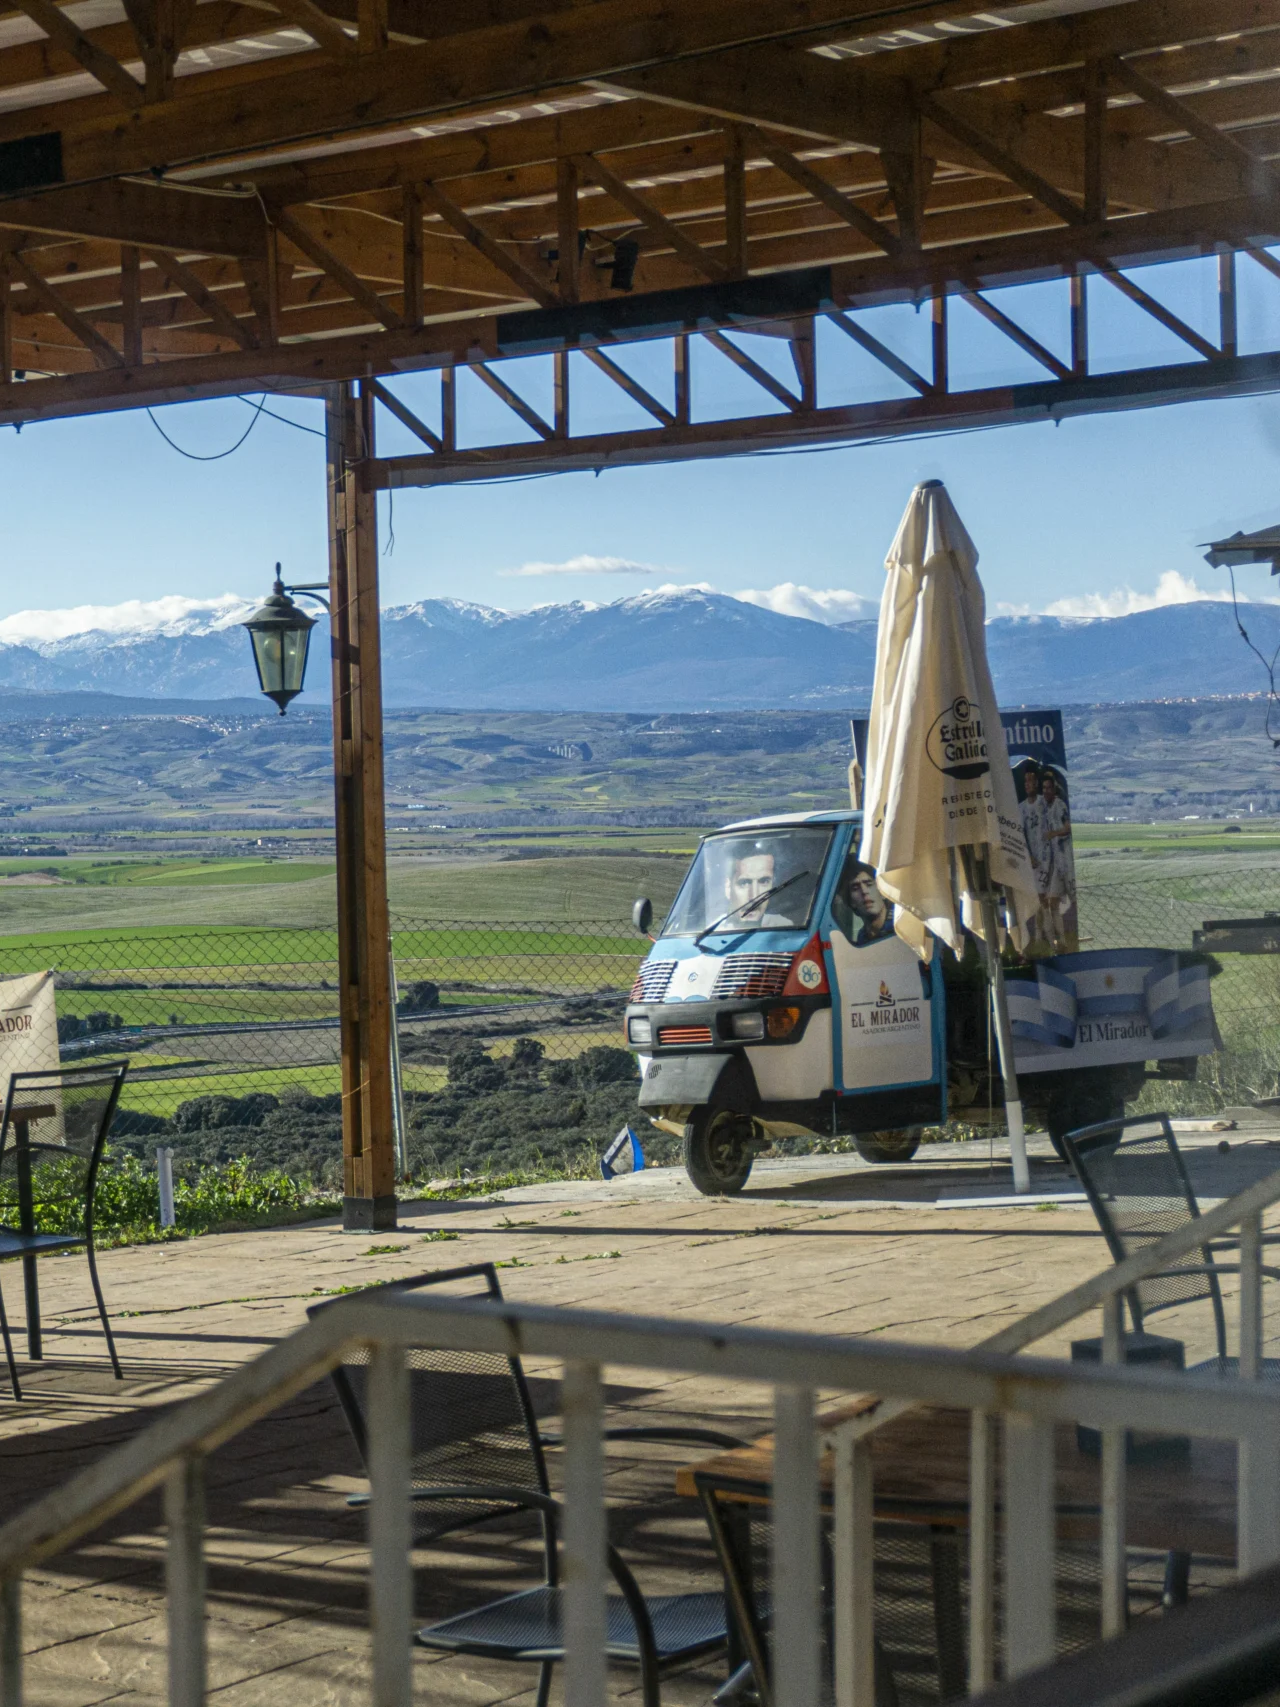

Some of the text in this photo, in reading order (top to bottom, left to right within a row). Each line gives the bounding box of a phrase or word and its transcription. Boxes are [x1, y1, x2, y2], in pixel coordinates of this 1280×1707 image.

[1006, 718, 1055, 745] ntino
[851, 1006, 920, 1028] EL MIRADOR
[1078, 1021, 1149, 1043] El Mirador
